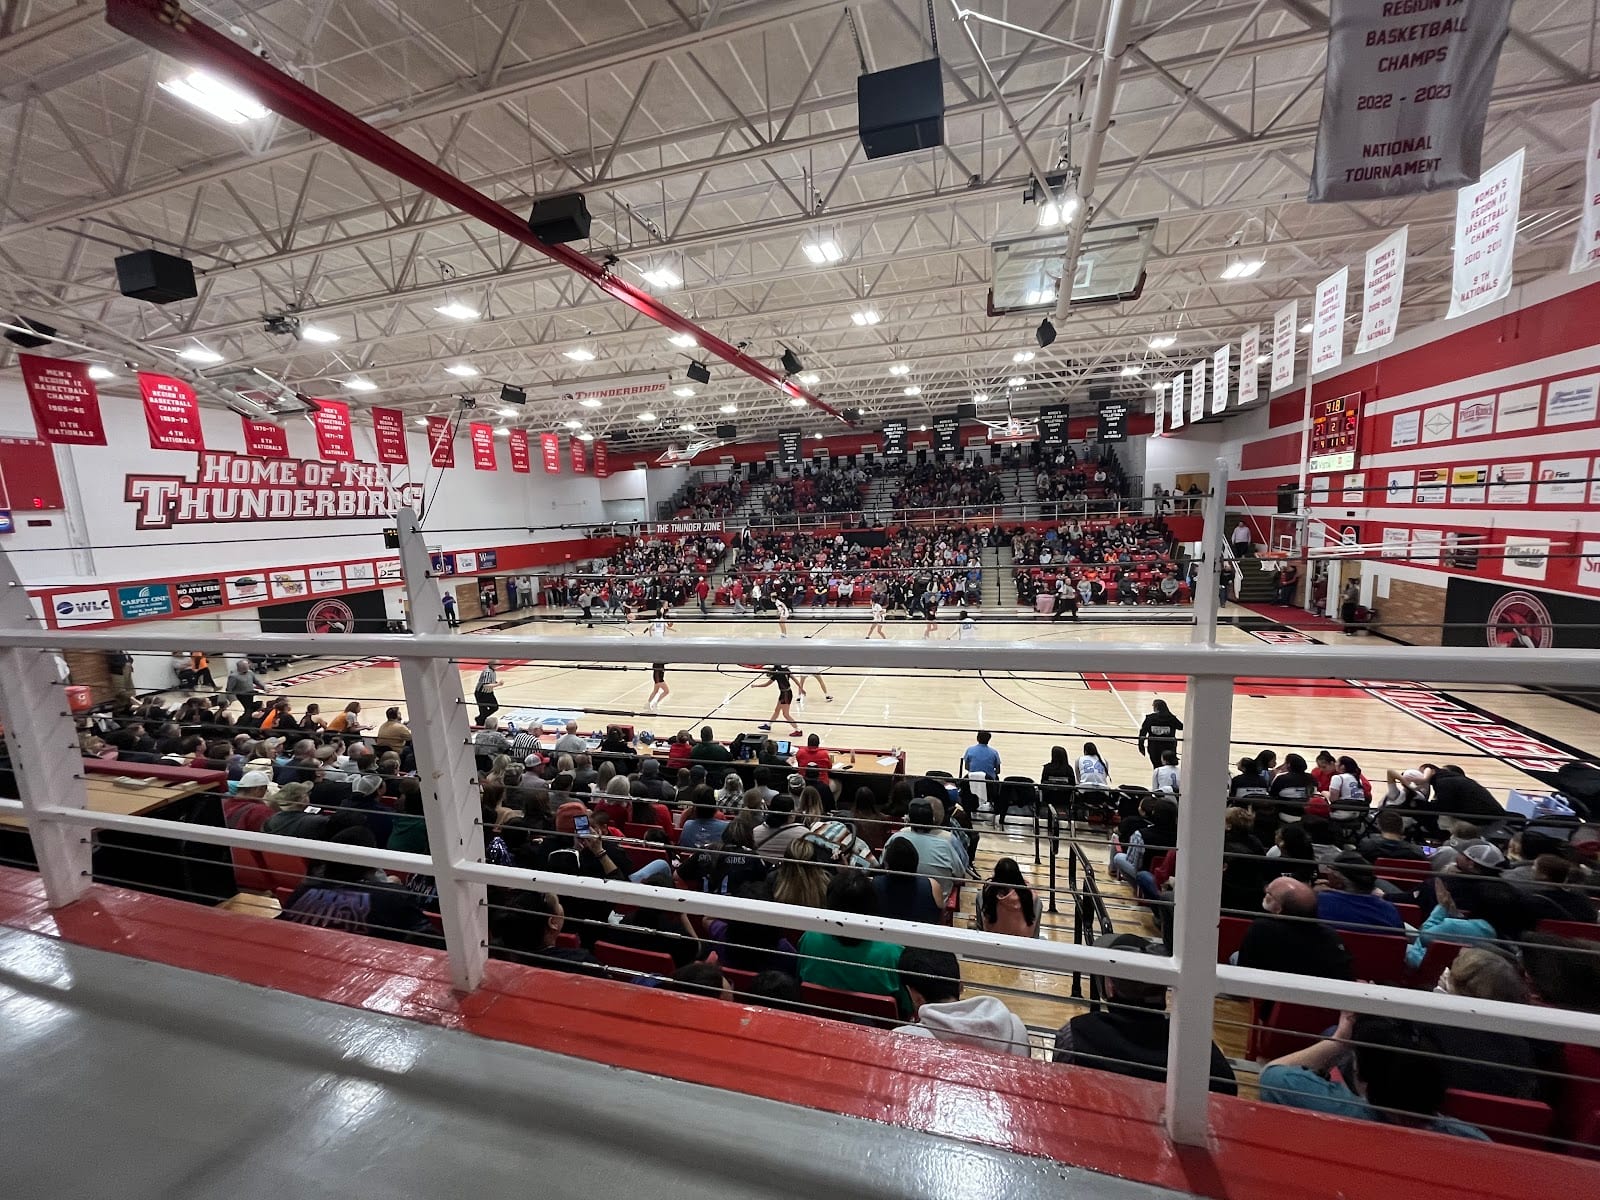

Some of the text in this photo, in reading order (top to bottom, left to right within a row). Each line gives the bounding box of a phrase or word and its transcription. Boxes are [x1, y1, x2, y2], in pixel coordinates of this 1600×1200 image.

[1383, 0, 1440, 17] REGION
[1366, 17, 1467, 46] BASKETBALL
[1378, 46, 1448, 73] CHAMPS
[1357, 93, 1392, 110] 2022
[1414, 84, 1452, 103] 2023
[1362, 135, 1433, 158] NATIONAL
[1345, 158, 1442, 183] TOURNAMENT
[1475, 178, 1507, 205] WOMEN'S
[1470, 199, 1498, 219] REGION
[1465, 204, 1509, 236] BASKETBALL
[1470, 223, 1500, 245] CHAMPS
[1368, 270, 1397, 289] BASKETBALL
[1481, 271, 1490, 283] TH
[1373, 282, 1391, 297] CHAMPS
[1460, 278, 1499, 302] NATIONALS
[1367, 326, 1391, 340] NATIONALS
[46, 369, 72, 378] MEN'S
[39, 376, 70, 386] REGION
[158, 384, 178, 392] MEN'S
[34, 383, 89, 395] BASKETBALL
[152, 390, 176, 399] REGION
[575, 383, 667, 400] THUNDERBIRDS
[47, 393, 81, 402] CHAMPS
[149, 397, 192, 407] BASKETBALL
[159, 405, 185, 413] CHAMPS
[48, 428, 94, 437] NATIONALS
[160, 436, 195, 444] NATIONALS
[253, 443, 282, 451] NATIONALS
[203, 455, 390, 487] HOME OF THE
[656, 521, 722, 533] THE THUNDER ZONE
[75, 599, 110, 612] WLC
[121, 597, 149, 606] CARPET
